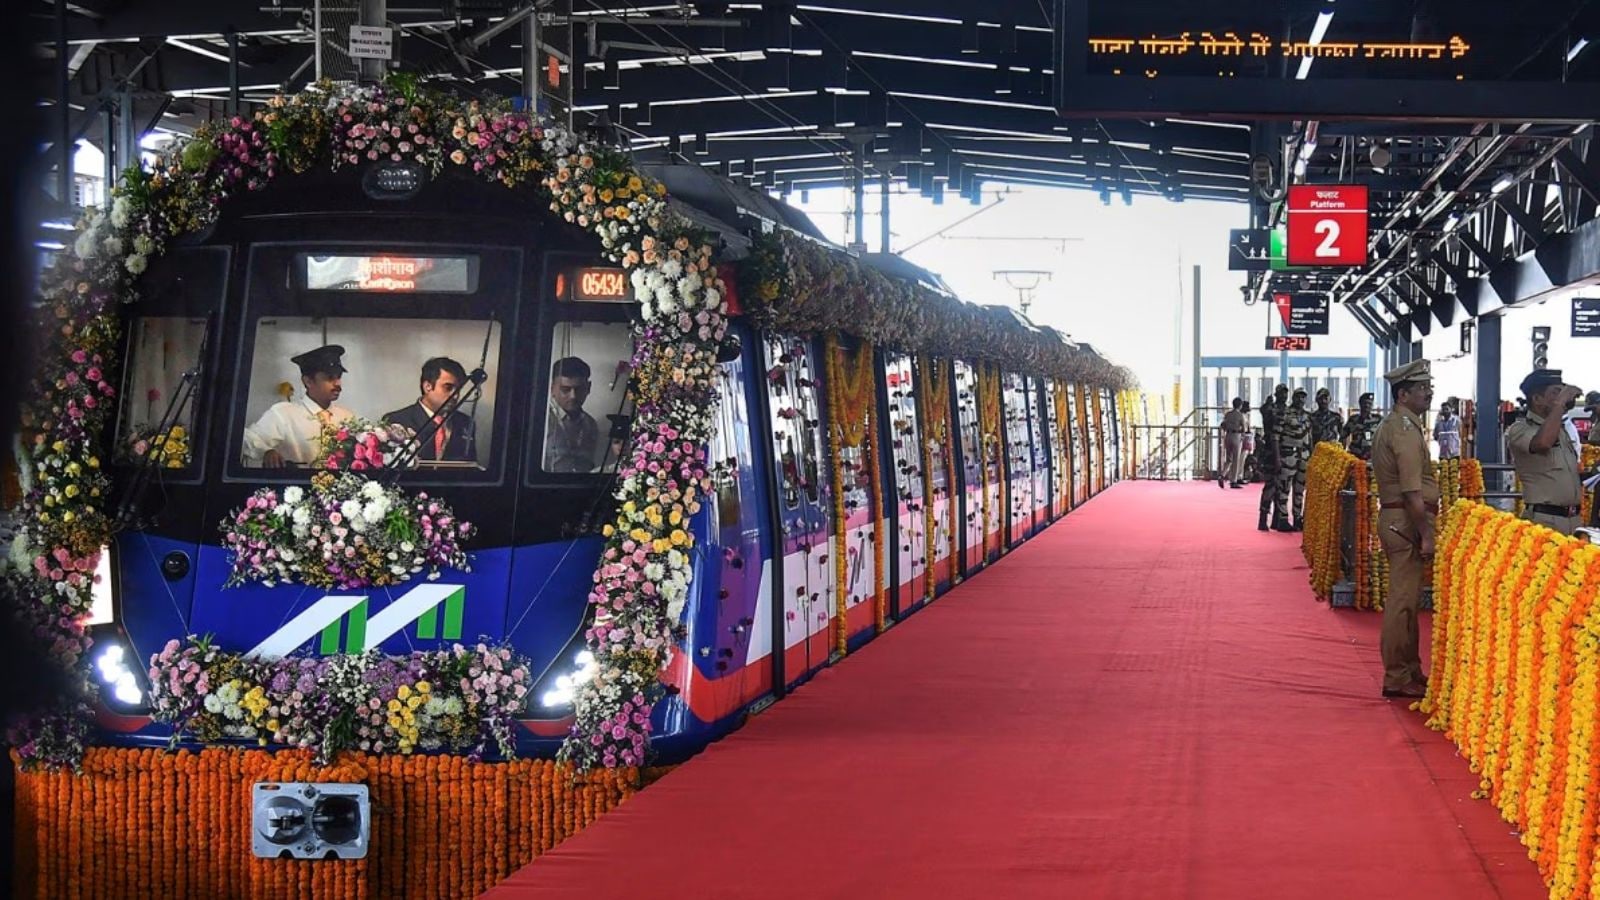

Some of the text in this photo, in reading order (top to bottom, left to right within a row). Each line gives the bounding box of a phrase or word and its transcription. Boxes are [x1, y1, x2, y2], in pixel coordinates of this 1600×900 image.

[1310, 200, 1346, 208] Platform
[1314, 218, 1341, 258] 2
[582, 272, 625, 296] 05434
[1272, 338, 1309, 350] 12:24
